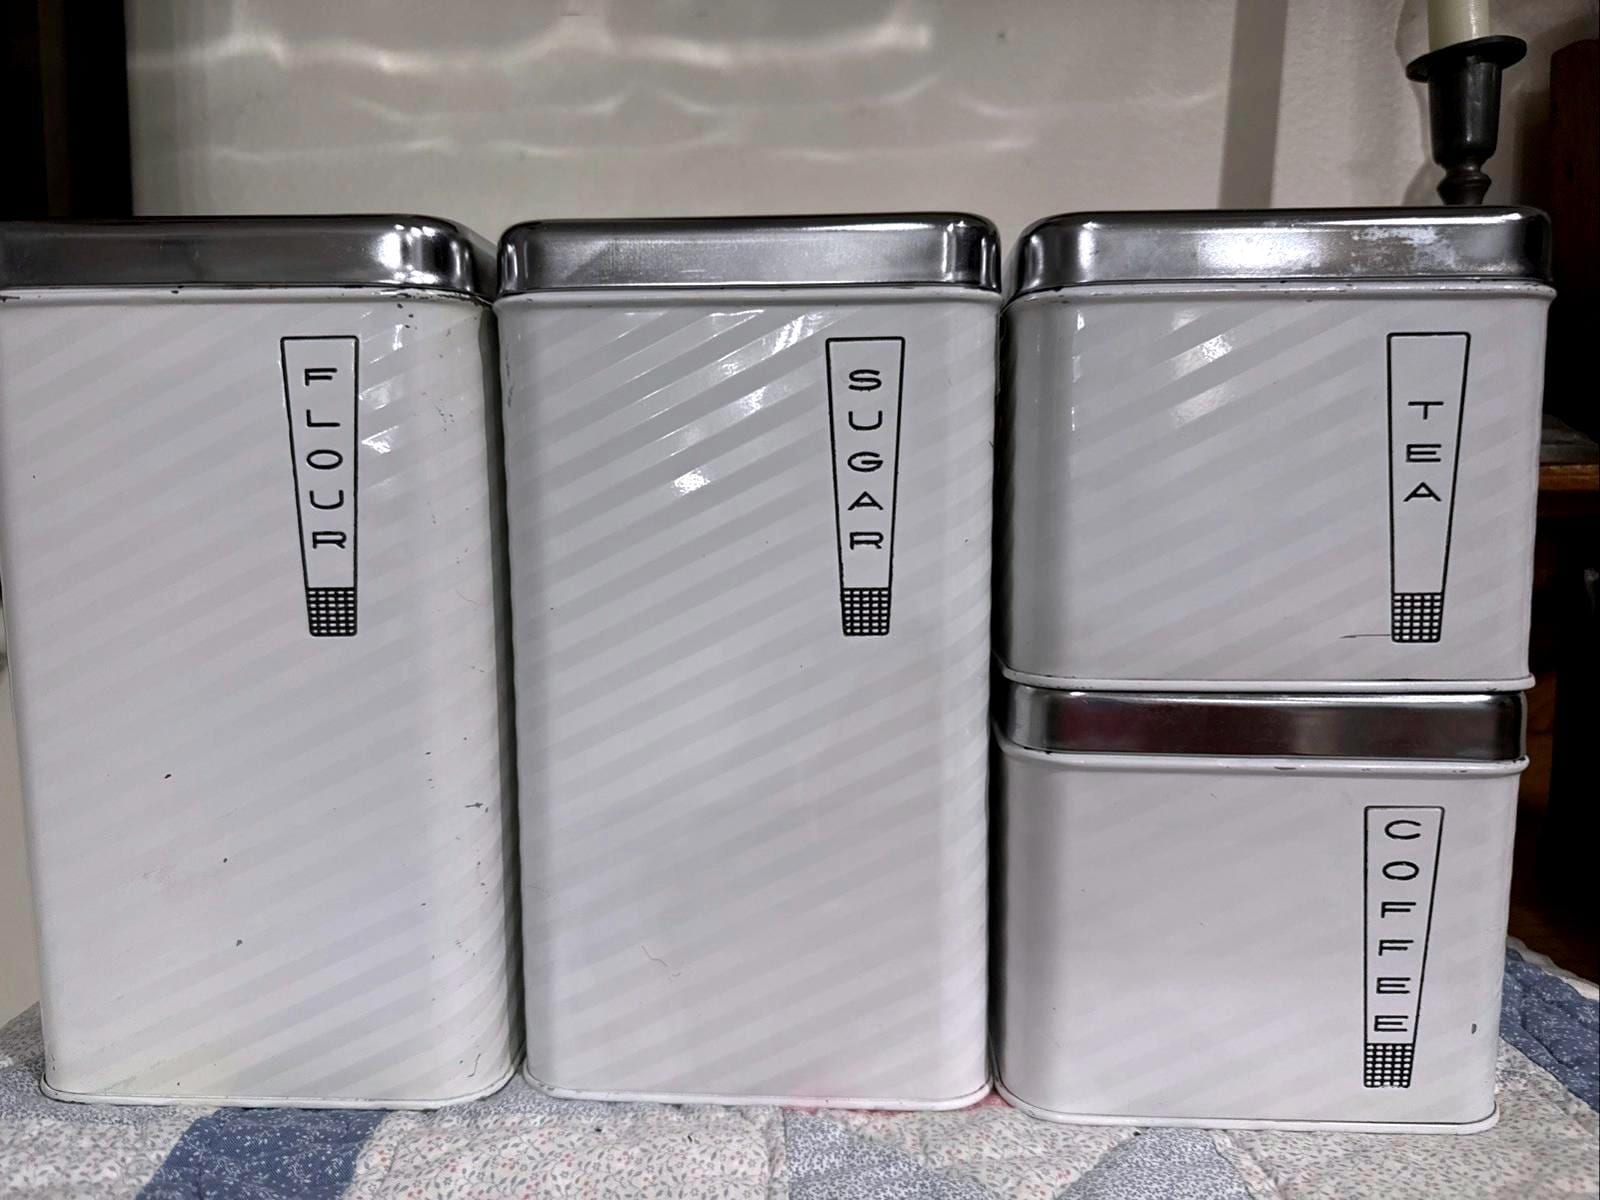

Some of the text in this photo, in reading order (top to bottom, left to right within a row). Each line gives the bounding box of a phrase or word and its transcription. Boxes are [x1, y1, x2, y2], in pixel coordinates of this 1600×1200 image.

[303, 367, 347, 550] FLOUR
[847, 368, 884, 551] SUGAR
[1403, 400, 1445, 503] TEA
[1373, 819, 1422, 1033] COFFEE
